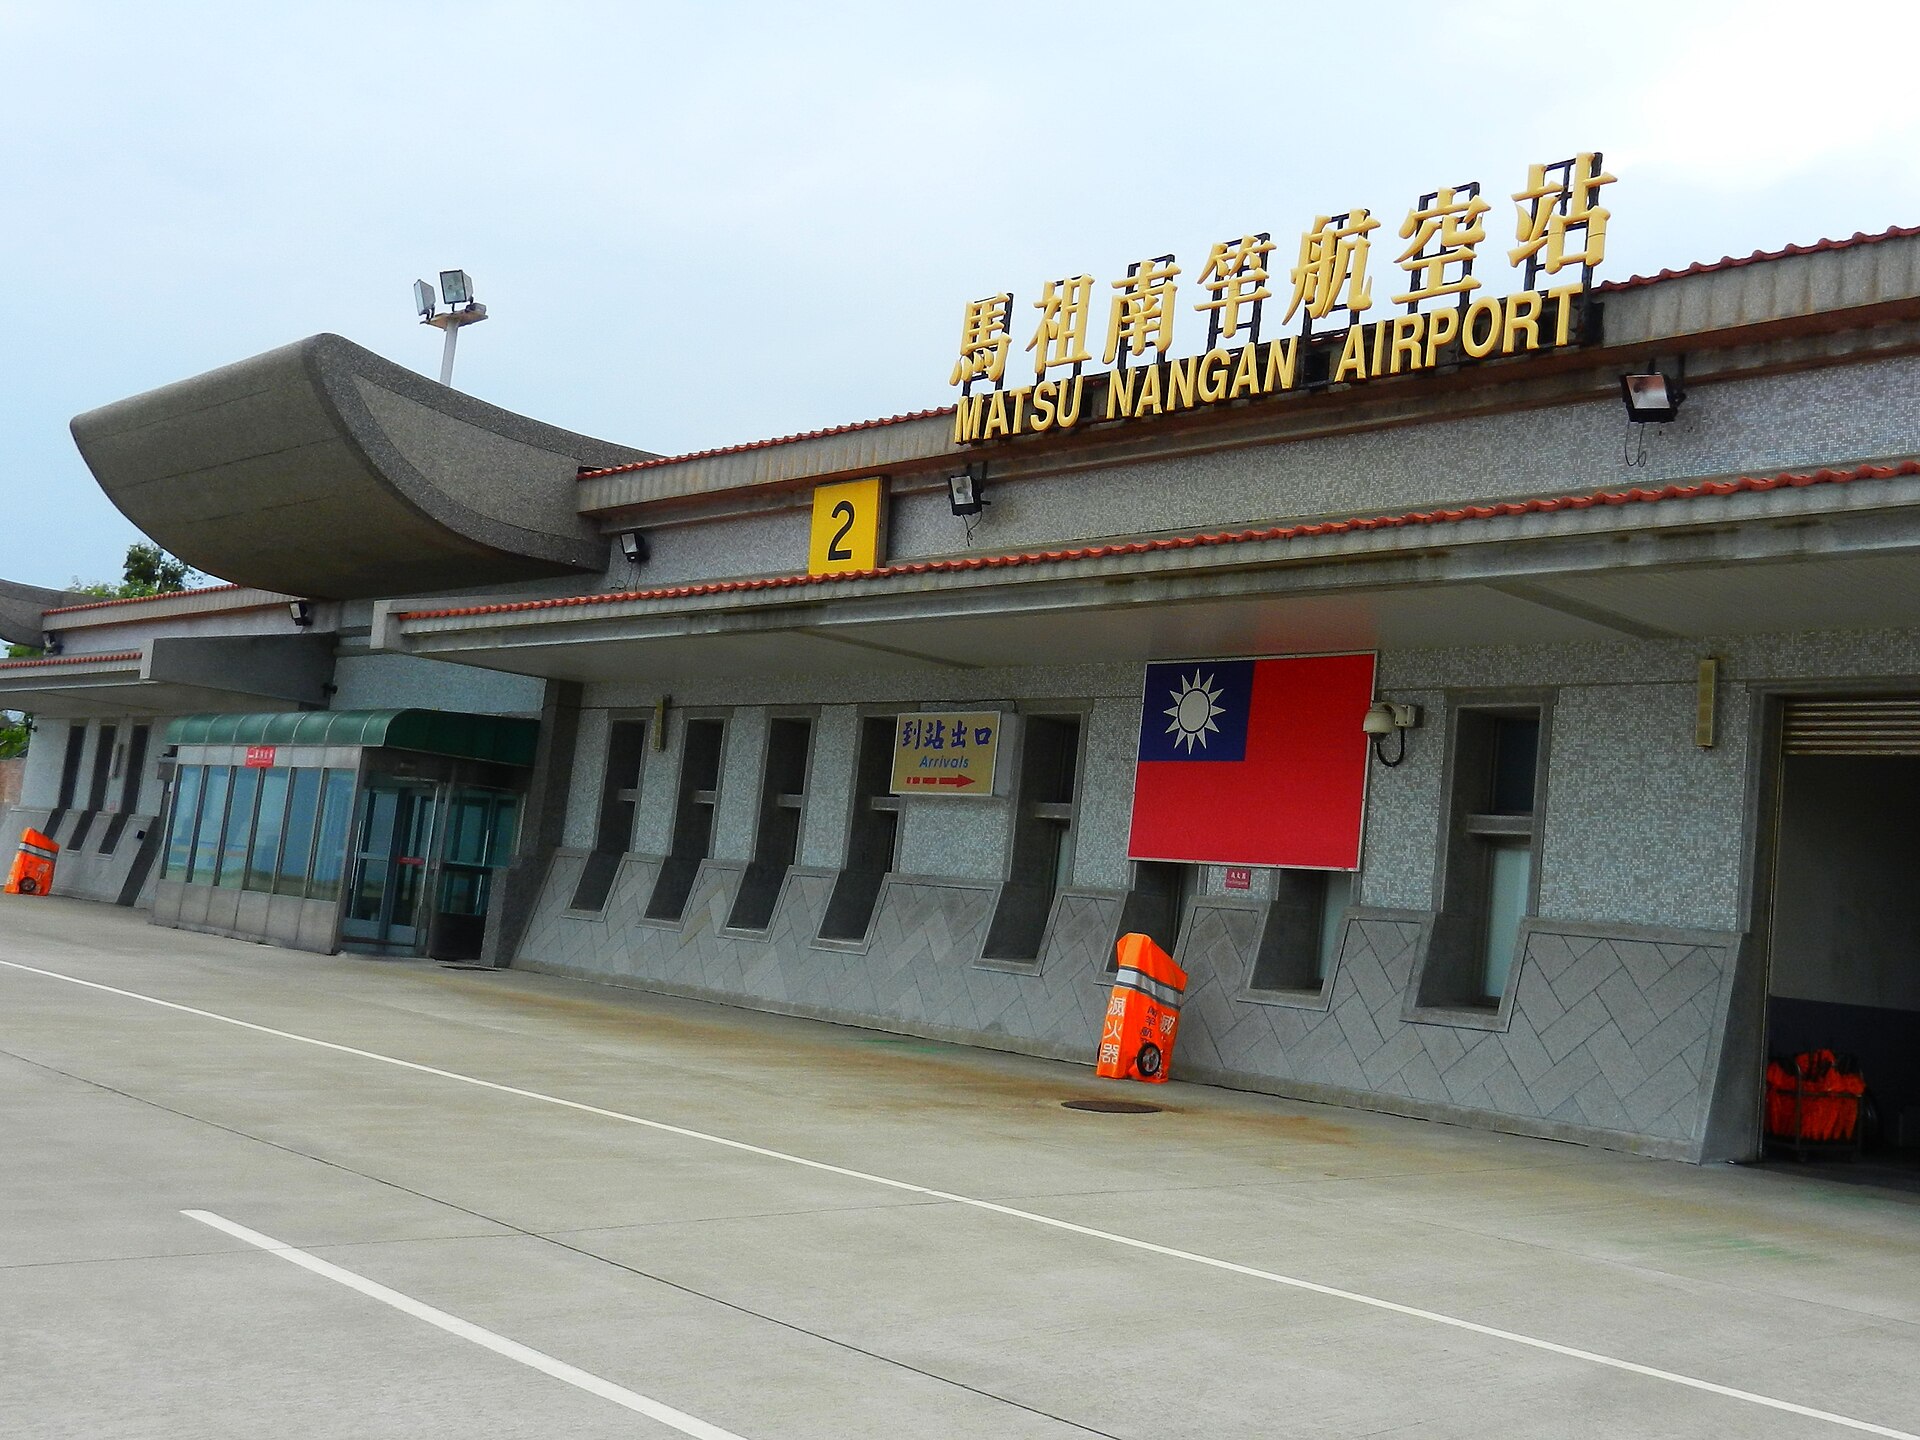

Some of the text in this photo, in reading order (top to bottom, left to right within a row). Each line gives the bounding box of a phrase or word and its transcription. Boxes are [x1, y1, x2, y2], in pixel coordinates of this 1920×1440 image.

[949, 152, 1618, 386] 馬祖南竿航空站
[954, 283, 1585, 444] MATSU NANGAN AIRPORT
[827, 500, 856, 561] 2
[902, 718, 992, 750] 到站出口
[919, 755, 969, 769] Arrivals
[1102, 995, 1127, 1064] 滅火器
